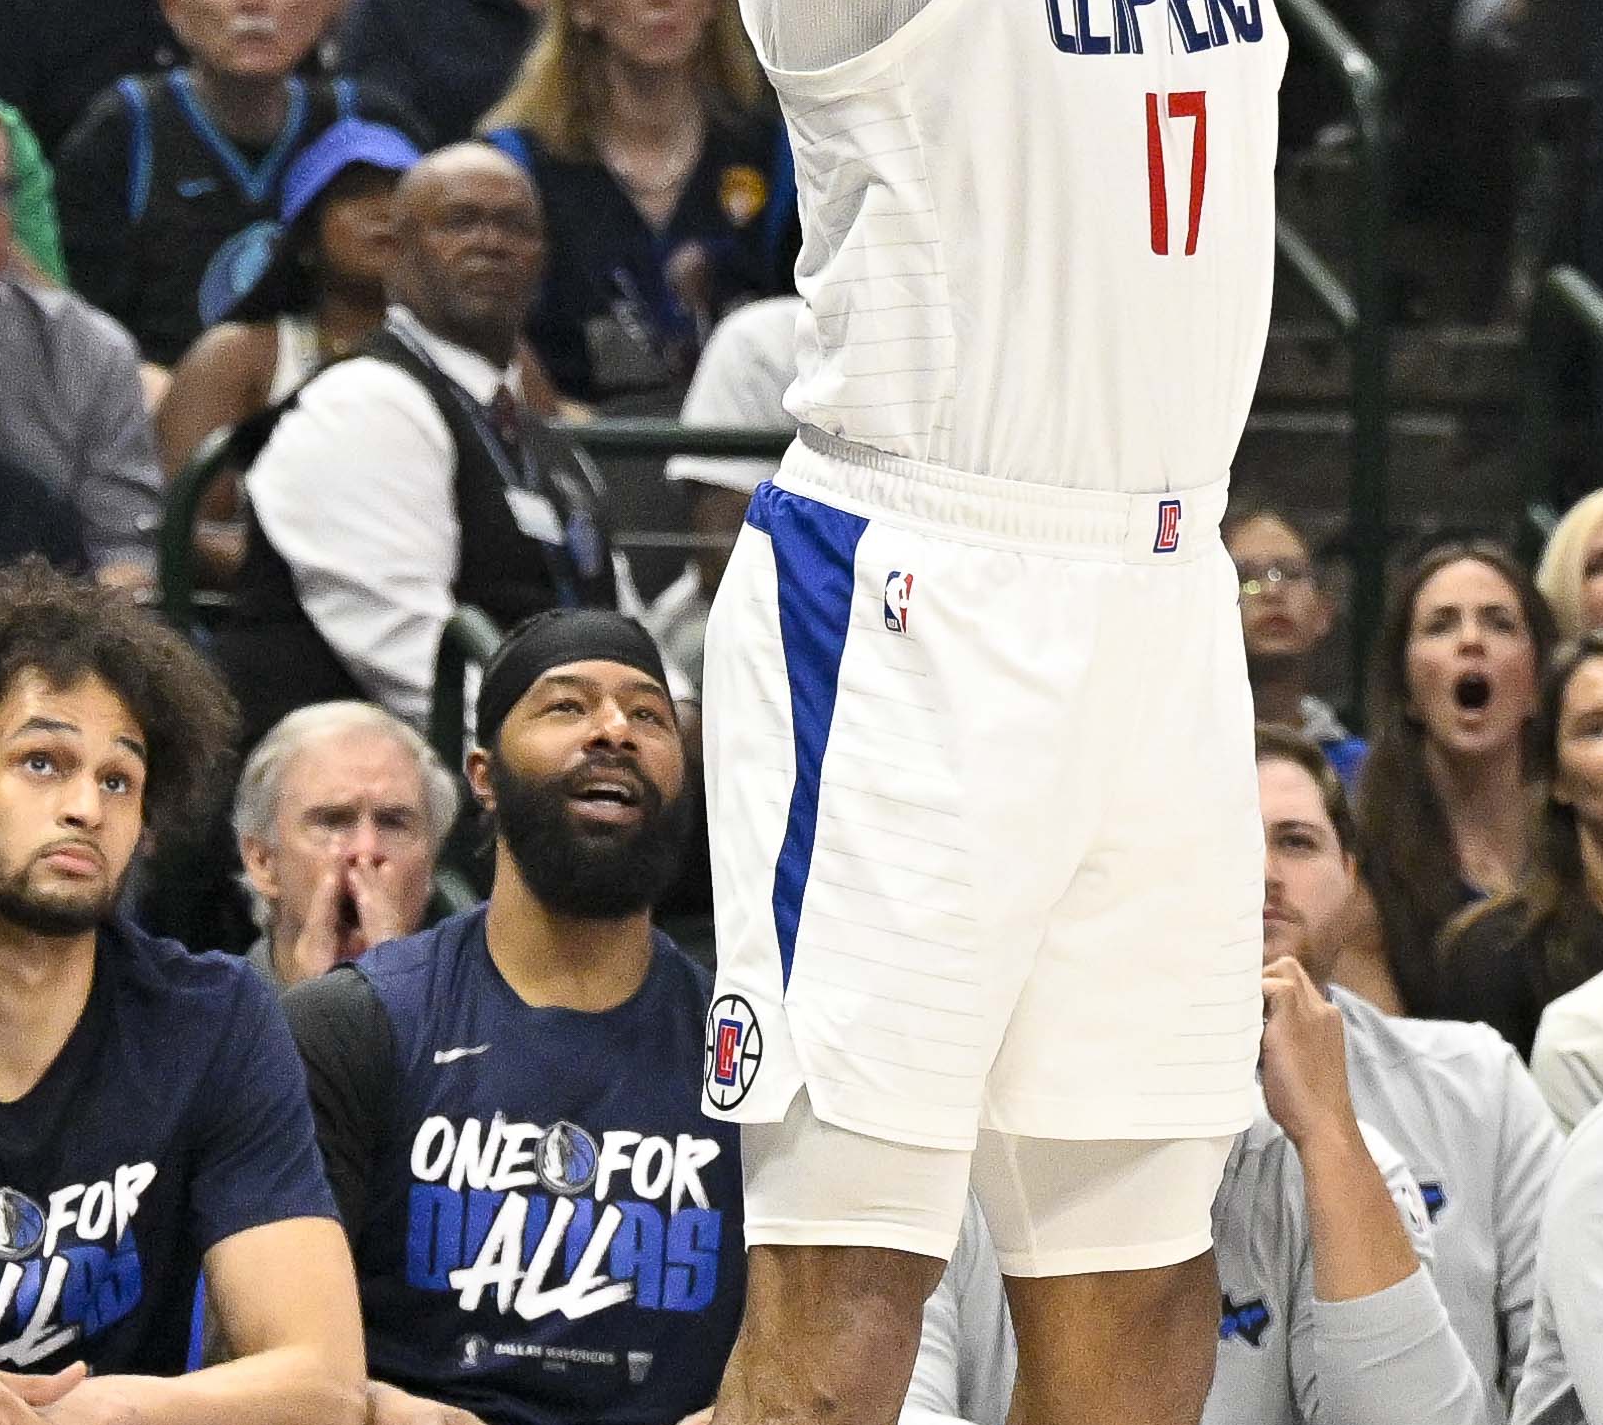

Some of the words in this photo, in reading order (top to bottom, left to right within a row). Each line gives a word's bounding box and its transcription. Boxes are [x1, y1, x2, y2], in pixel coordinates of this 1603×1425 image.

[1145, 90, 1207, 256] 17
[42, 1161, 158, 1259] FOR
[410, 1111, 547, 1193] ONE
[594, 1131, 721, 1215] FOR
[448, 1191, 634, 1321] ALL
